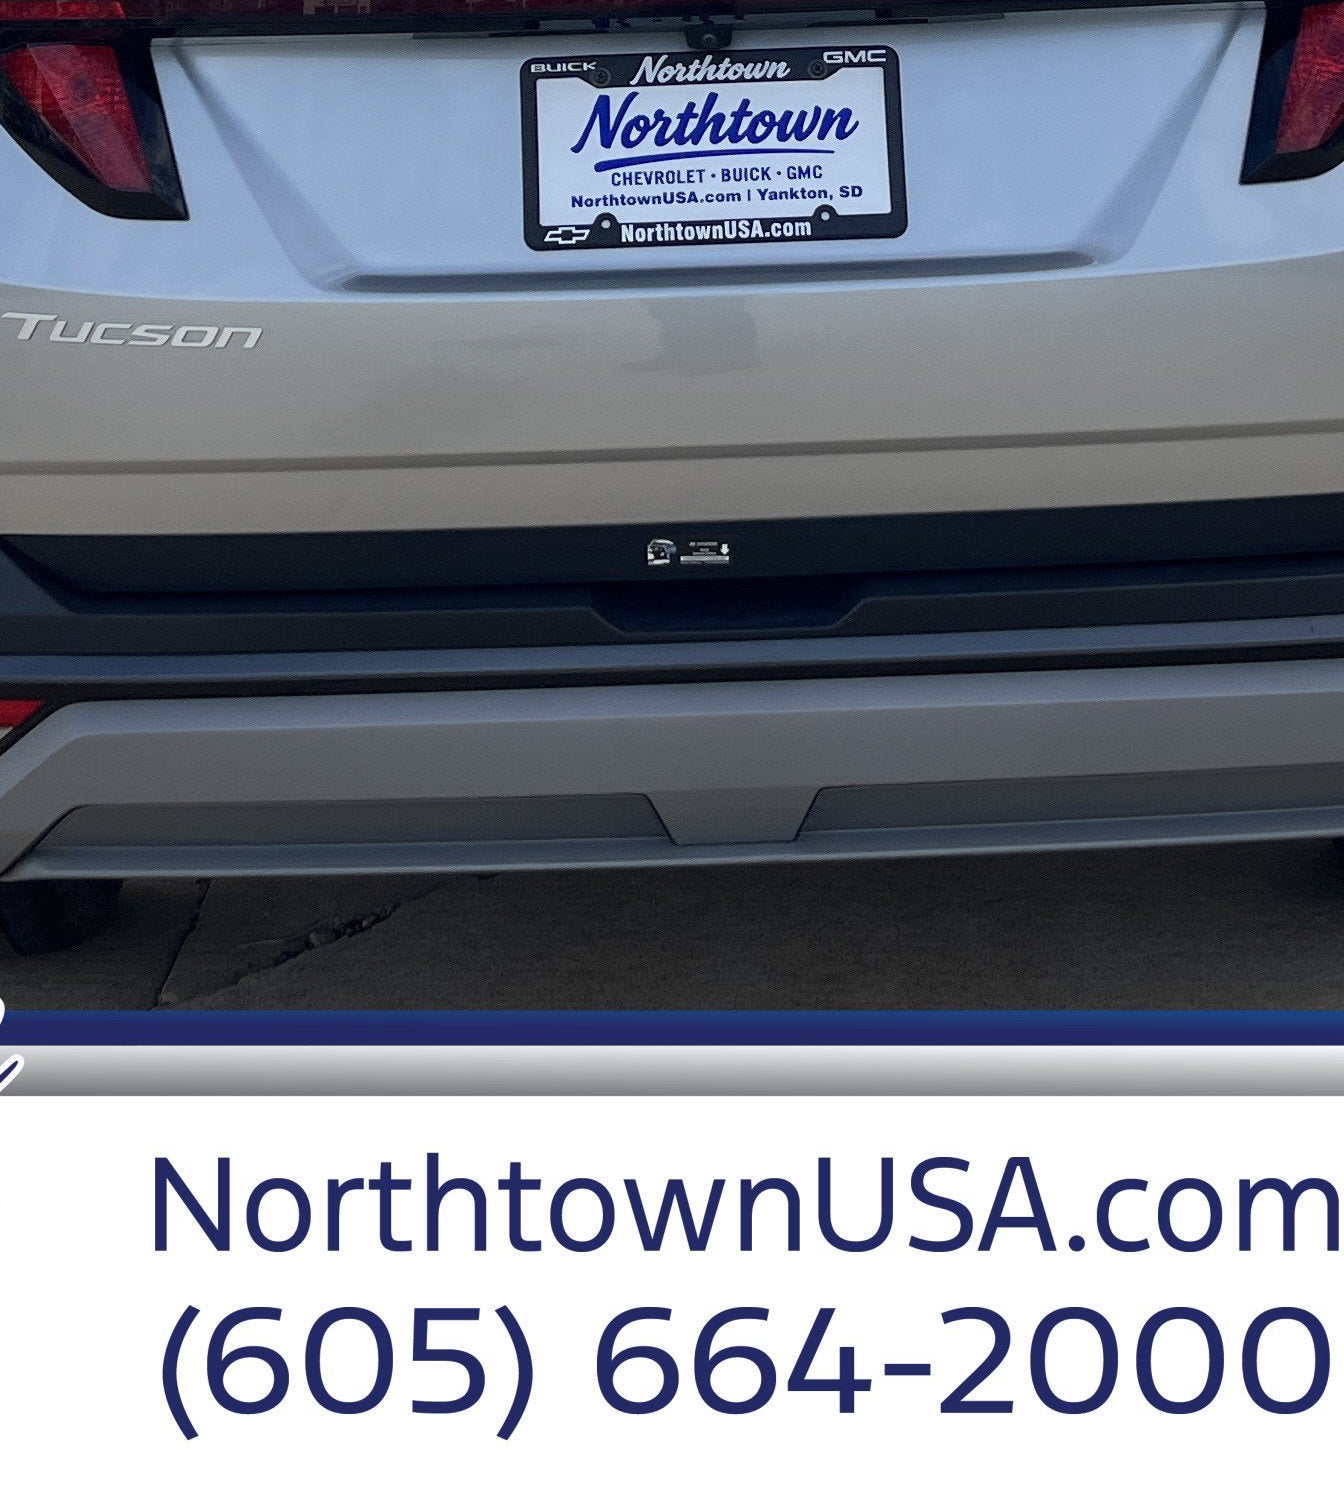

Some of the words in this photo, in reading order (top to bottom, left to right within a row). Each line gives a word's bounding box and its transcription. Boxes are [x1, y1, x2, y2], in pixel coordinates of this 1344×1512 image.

[530, 61, 597, 74] BUICK
[629, 54, 791, 86] Northtown
[822, 49, 888, 65] GMC
[570, 91, 860, 154] Northtown
[610, 168, 706, 187] CHEVROLET
[720, 165, 772, 183] BUICK
[786, 164, 824, 181] GMC
[570, 190, 742, 208] NorthtownUSA.com
[756, 186, 834, 202] Yankton,
[838, 185, 864, 199] SD
[620, 218, 812, 243] NorthtownUSA.com
